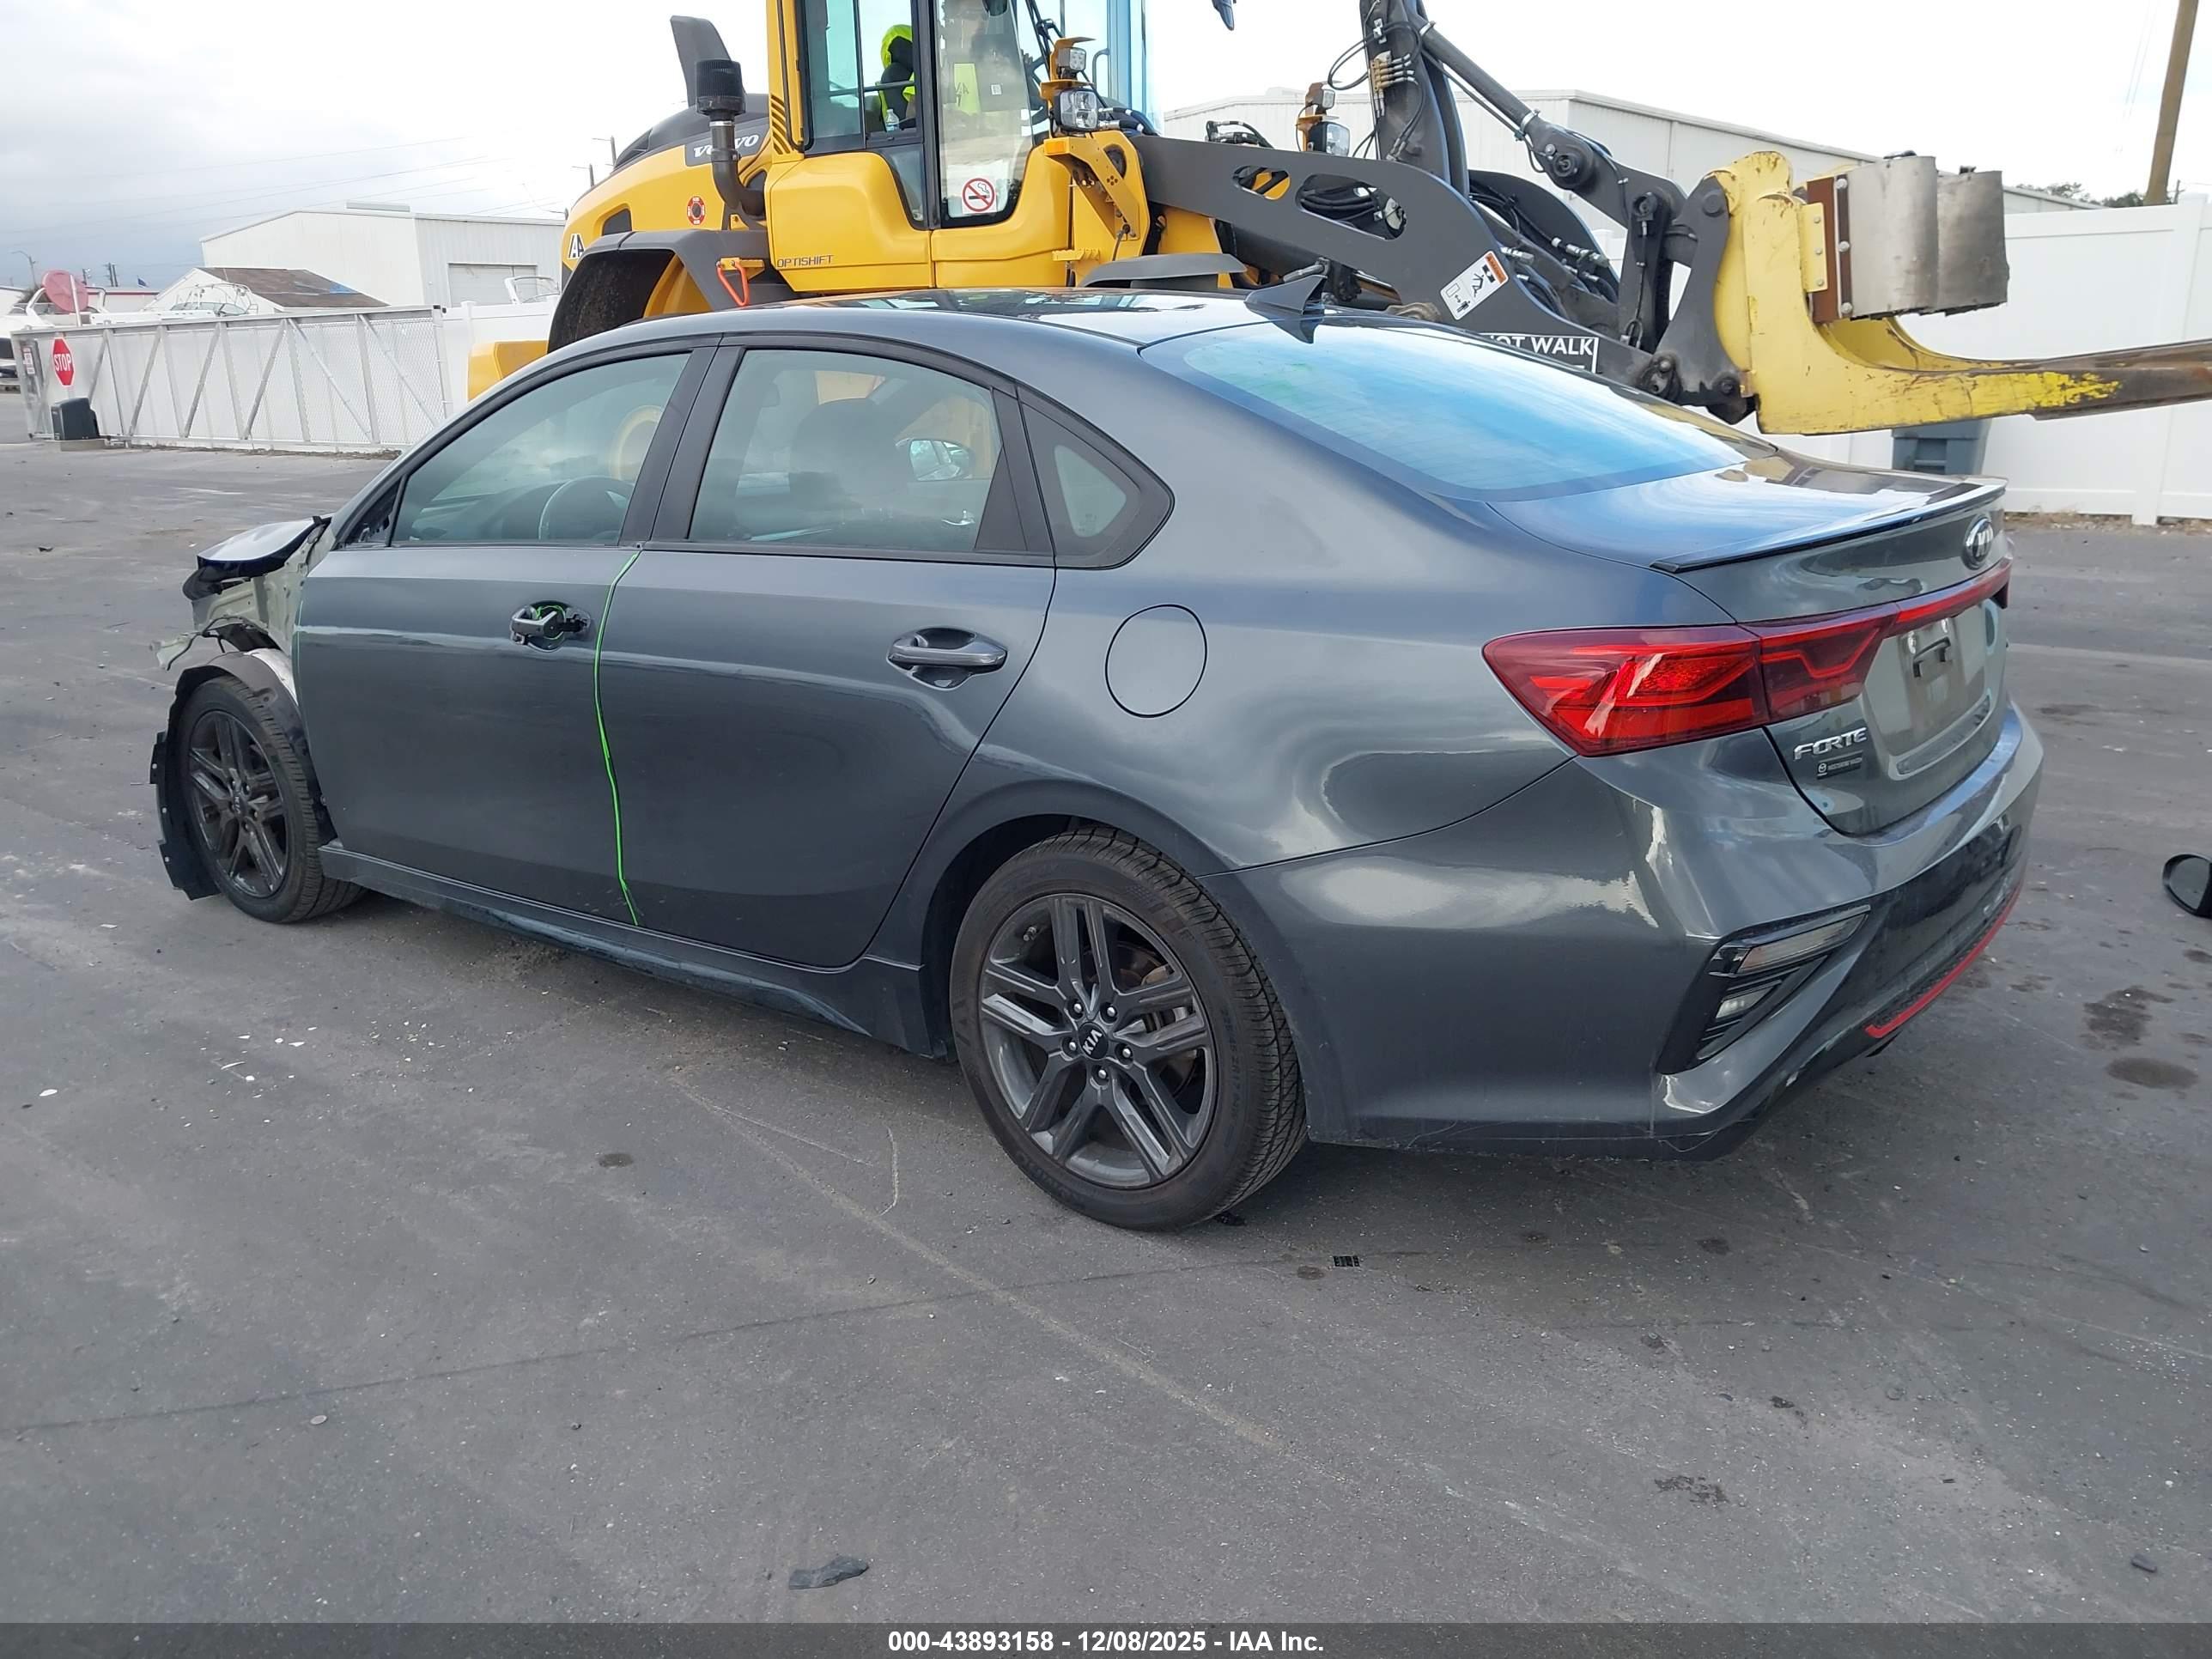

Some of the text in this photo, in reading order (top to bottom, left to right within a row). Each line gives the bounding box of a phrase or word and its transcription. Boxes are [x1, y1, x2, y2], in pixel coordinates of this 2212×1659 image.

[693, 134, 760, 158] VVO
[776, 254, 835, 268] OPTISHIFT
[1530, 336, 1594, 356] WALK
[53, 353, 72, 372] STOP
[1794, 726, 1868, 760] FORTE
[1082, 1029, 1103, 1055] KIA
